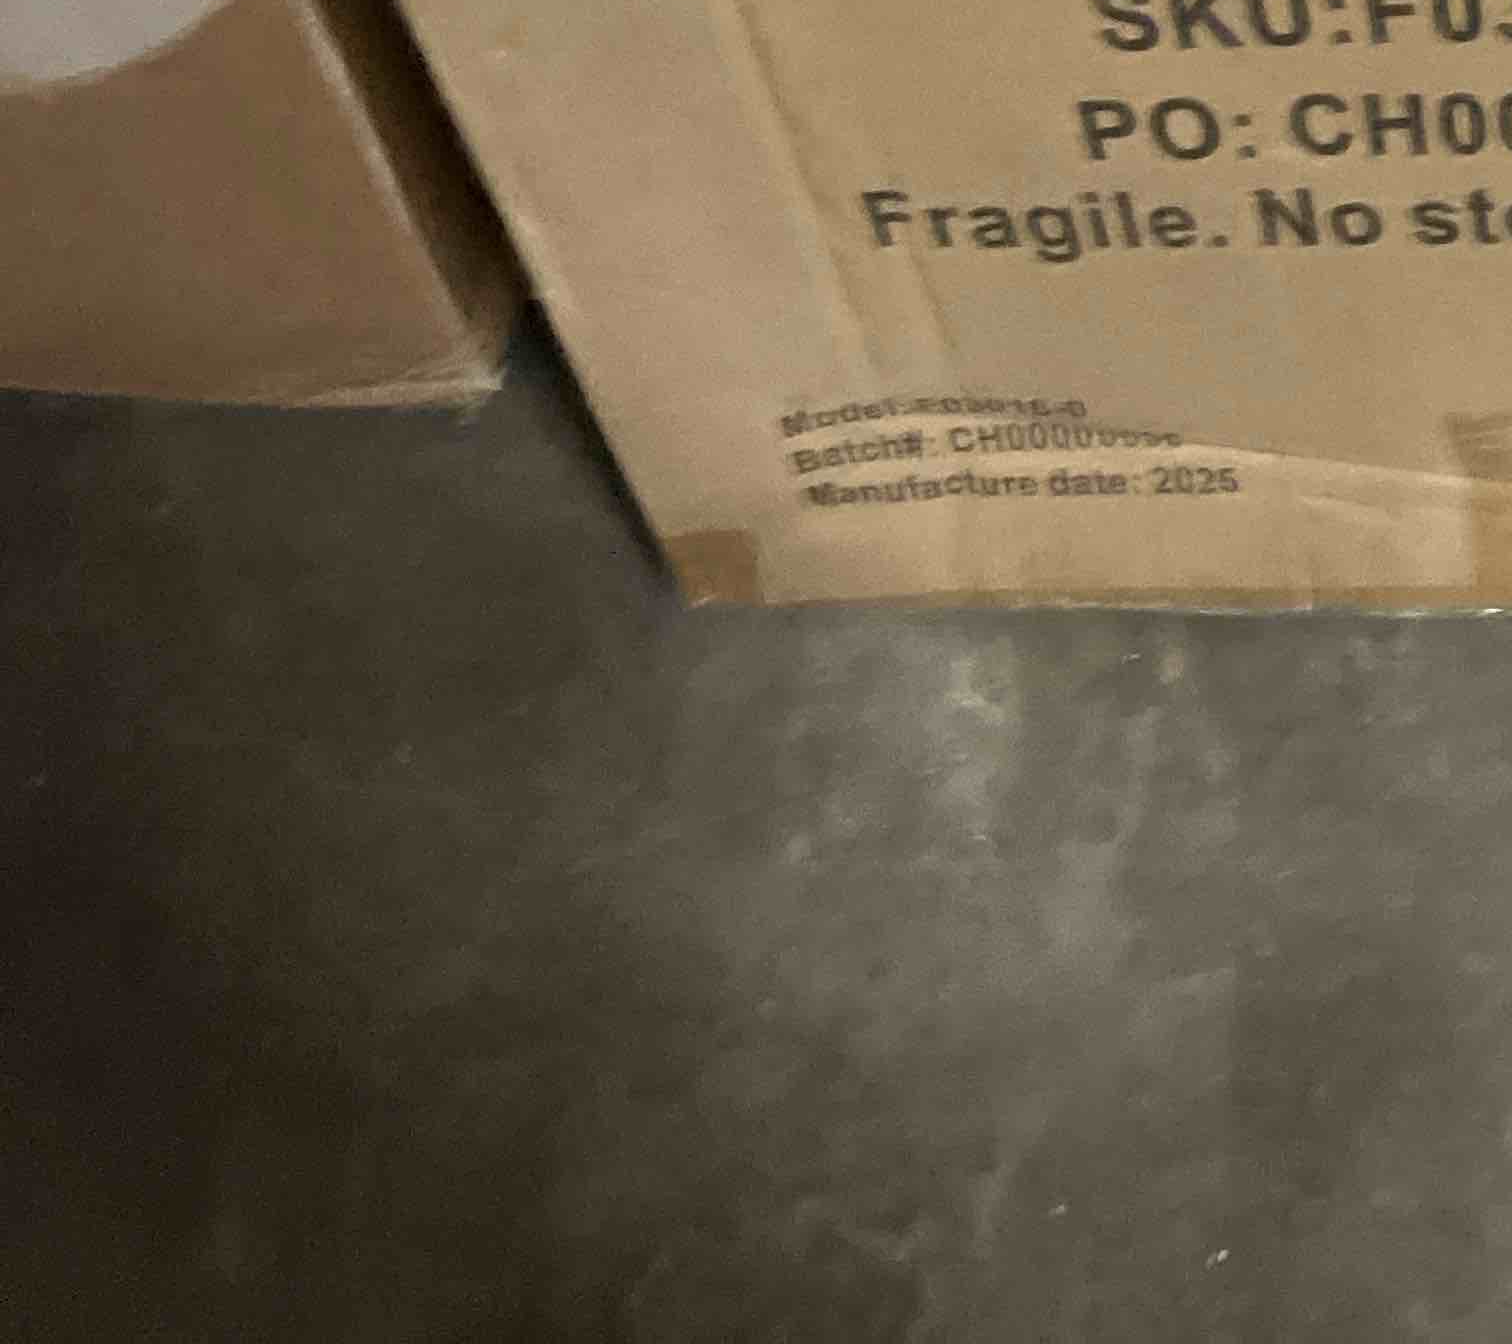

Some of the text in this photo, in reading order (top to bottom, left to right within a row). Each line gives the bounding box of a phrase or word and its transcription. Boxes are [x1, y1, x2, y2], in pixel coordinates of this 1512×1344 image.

[1076, 96, 1257, 161] PO:
[860, 189, 1229, 263] Fragile.
[1253, 187, 1384, 247] No
[806, 465, 1241, 508] Manufacture date: 2025
